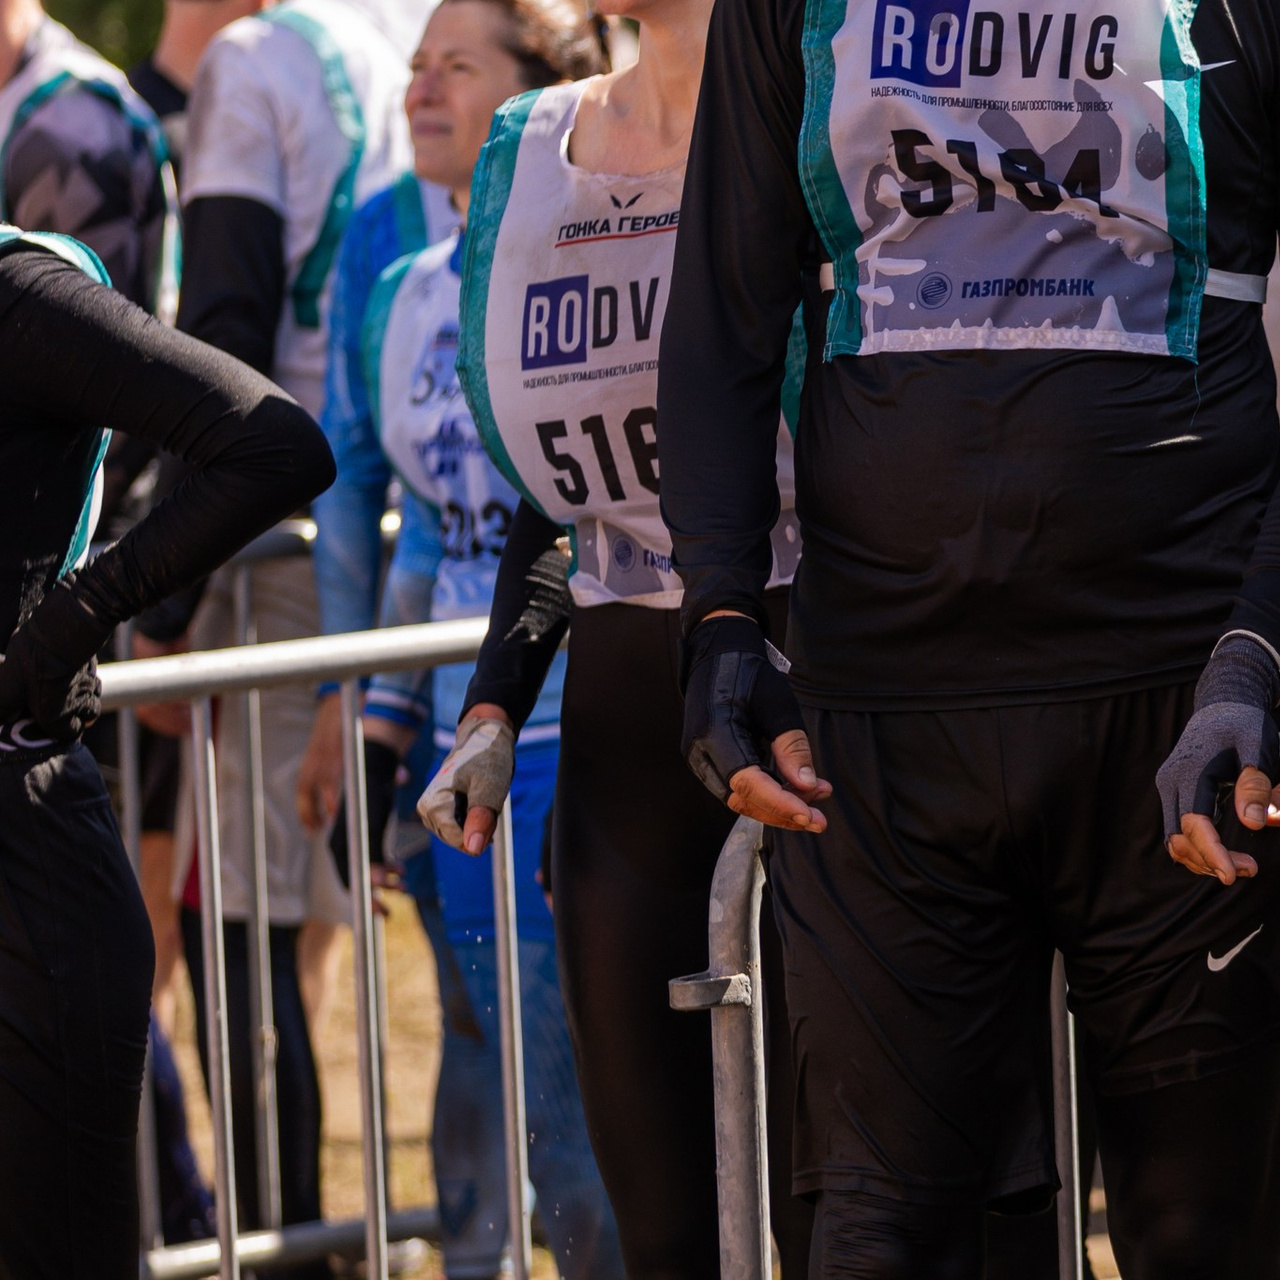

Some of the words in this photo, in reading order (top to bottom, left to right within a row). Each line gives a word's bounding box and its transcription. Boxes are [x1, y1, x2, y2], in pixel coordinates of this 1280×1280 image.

[881, 4, 1119, 80] RODVIG
[871, 86, 921, 101] НАДЕЖНОСТЬ
[921, 95, 937, 107] ДЛЯ
[558, 219, 611, 241] ГОНКА
[617, 210, 680, 232] ГЕРОЕ
[961, 278, 1095, 298] ГАЗПРОМБАНК
[528, 277, 660, 358] RODV
[535, 406, 660, 506] 516
